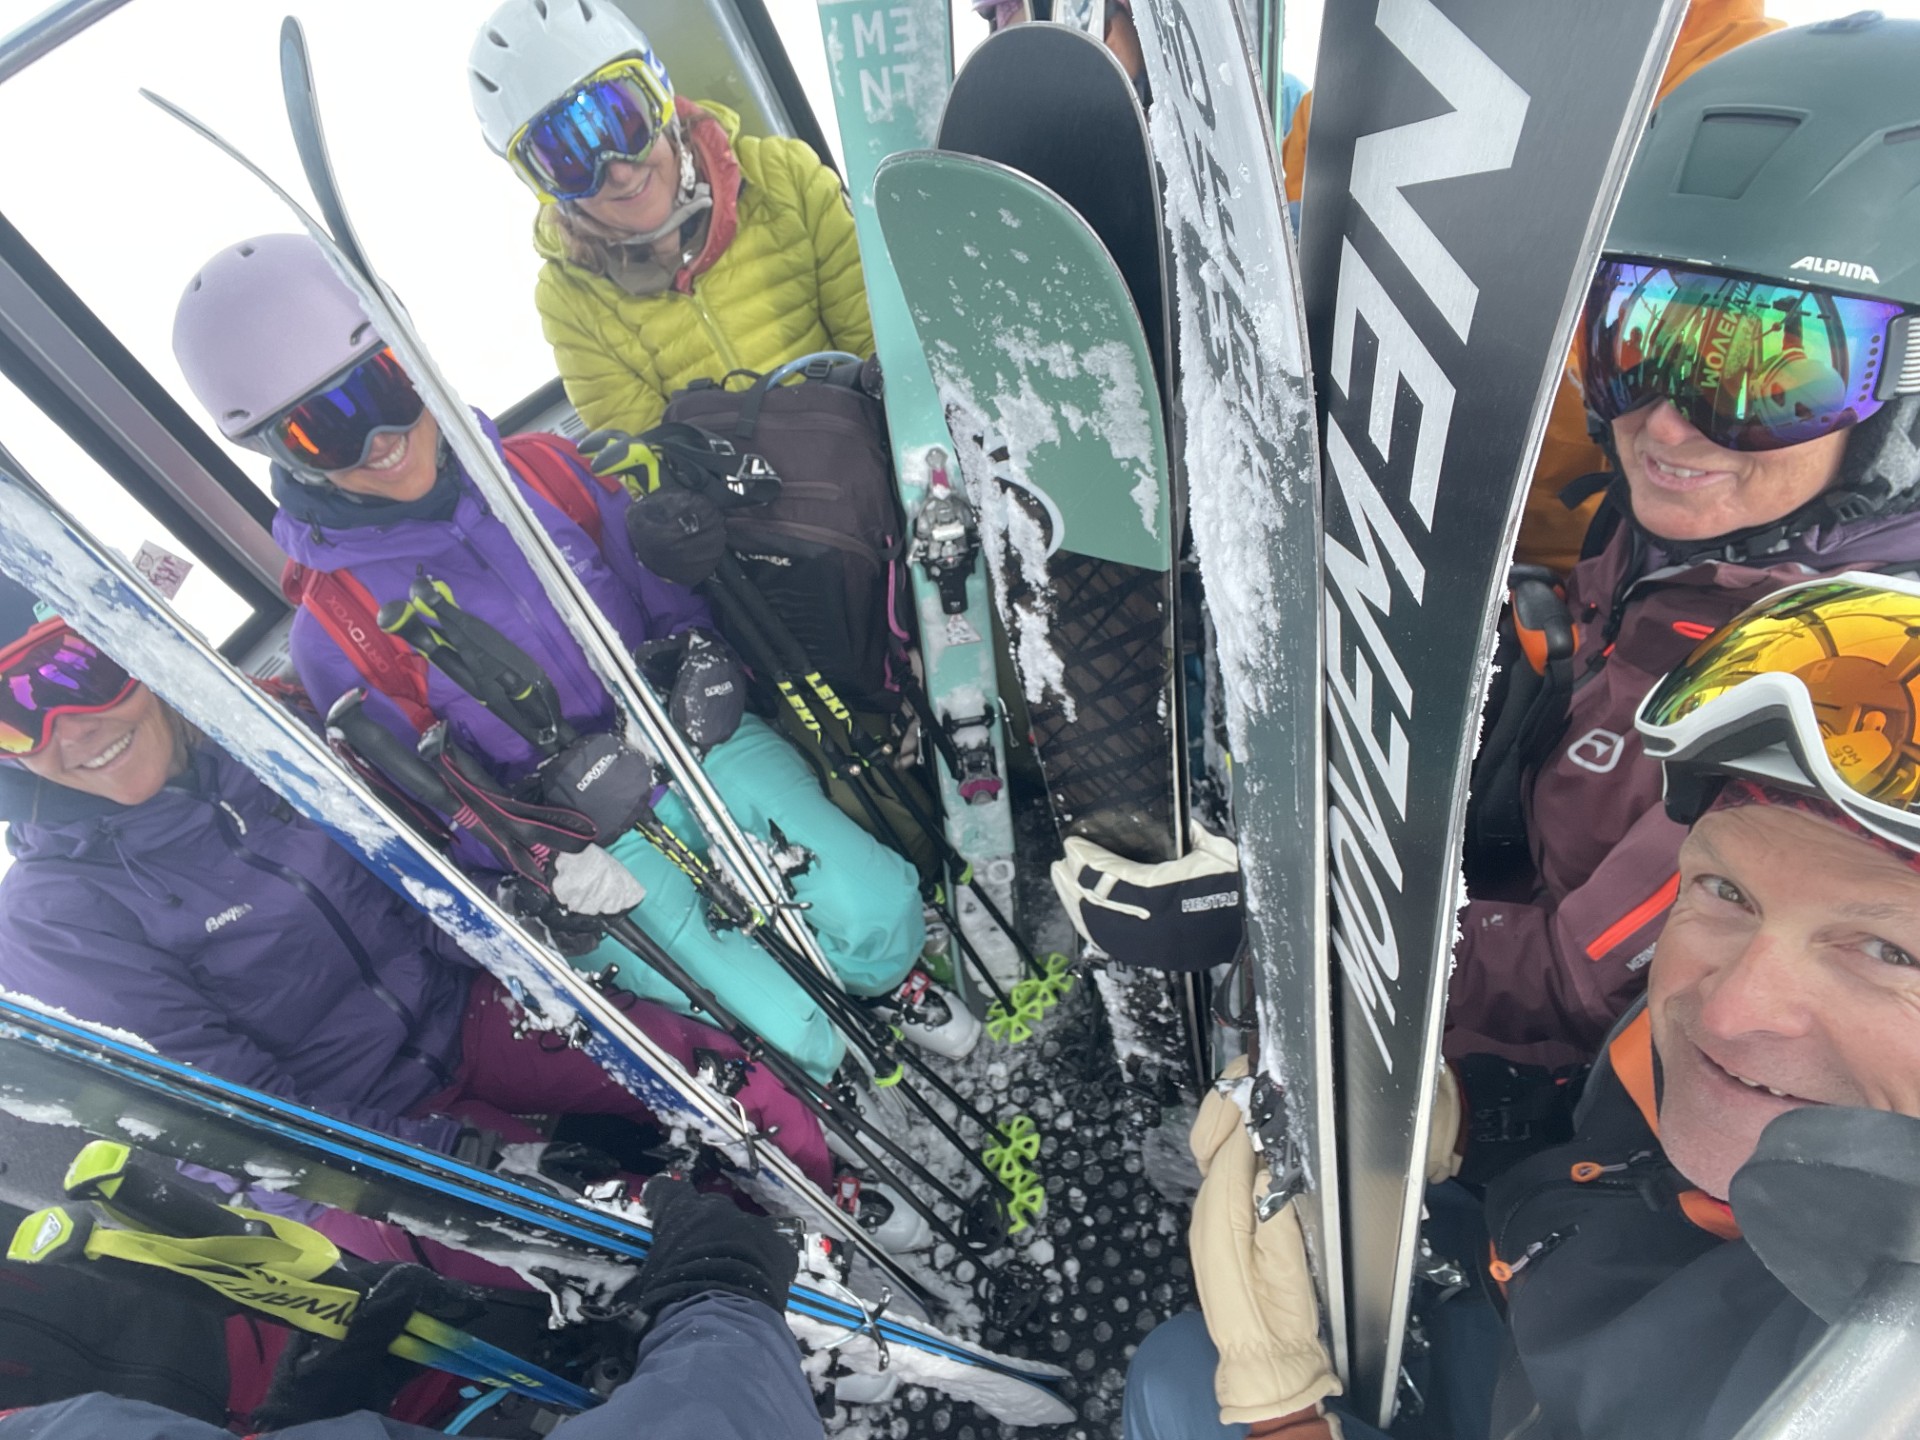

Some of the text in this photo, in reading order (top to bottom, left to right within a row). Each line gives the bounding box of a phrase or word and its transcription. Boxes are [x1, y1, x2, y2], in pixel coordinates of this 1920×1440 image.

[851, 7, 917, 58] ME
[1790, 255, 1879, 284] ALPINA
[326, 596, 389, 673] ORTOVOX
[777, 681, 820, 730] LEKI
[805, 671, 849, 719] LEKI
